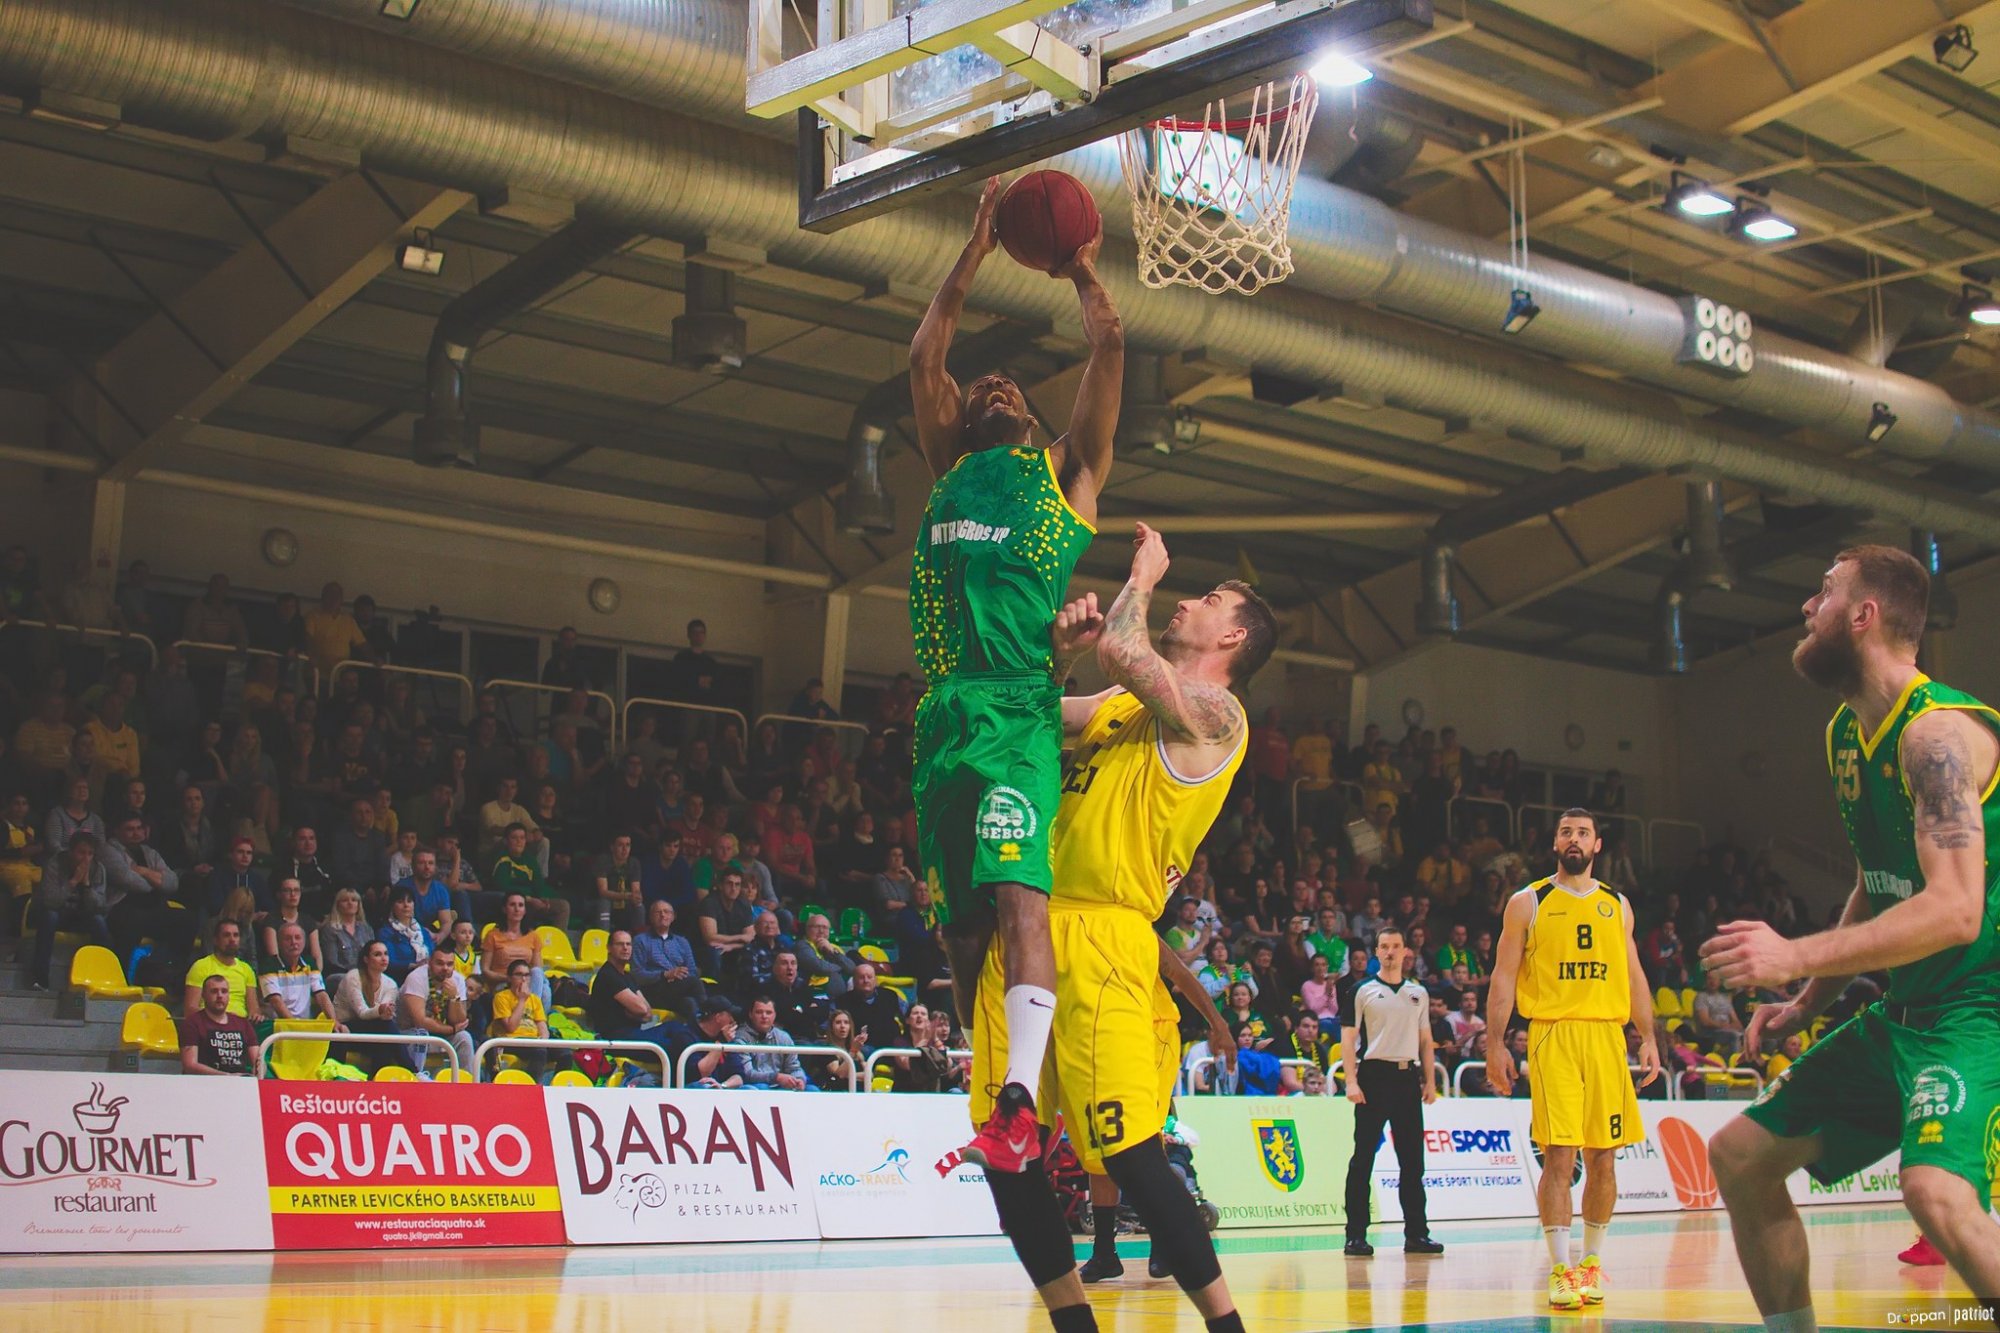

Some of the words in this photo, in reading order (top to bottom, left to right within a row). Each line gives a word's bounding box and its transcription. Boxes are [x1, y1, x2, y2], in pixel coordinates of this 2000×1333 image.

[1576, 924, 1593, 950] 8
[1558, 961, 1608, 981] INTER
[210, 1039, 243, 1048] UNDER
[279, 1093, 402, 1116] Reštaurácia
[1084, 1100, 1125, 1149] 13
[1609, 1113, 1622, 1140] 8
[0, 1120, 205, 1181] GOURMET
[284, 1121, 532, 1180] QUATRO
[565, 1101, 795, 1197] BARAN
[1424, 1130, 1512, 1153] ERSPORT
[934, 1147, 967, 1180] KR
[673, 1182, 723, 1196] PIZZA
[819, 1171, 905, 1187] AČKO-TRAVEL
[1445, 1173, 1472, 1187] ŠPORT
[1860, 1168, 1901, 1192] Levic
[54, 1192, 158, 1213] restaurant
[291, 1192, 357, 1208] PARTNER
[362, 1189, 446, 1208] LEVICKÉHO
[450, 1192, 536, 1208] BASKETBALU
[678, 1205, 687, 1217] &
[694, 1203, 799, 1217] RESTAURANT
[1216, 1205, 1291, 1221] ODPORUJEME
[1293, 1200, 1328, 1217] ŠPORT
[1329, 1203, 1338, 1214] V
[354, 1217, 486, 1231] www.restauraciaquatro.sk
